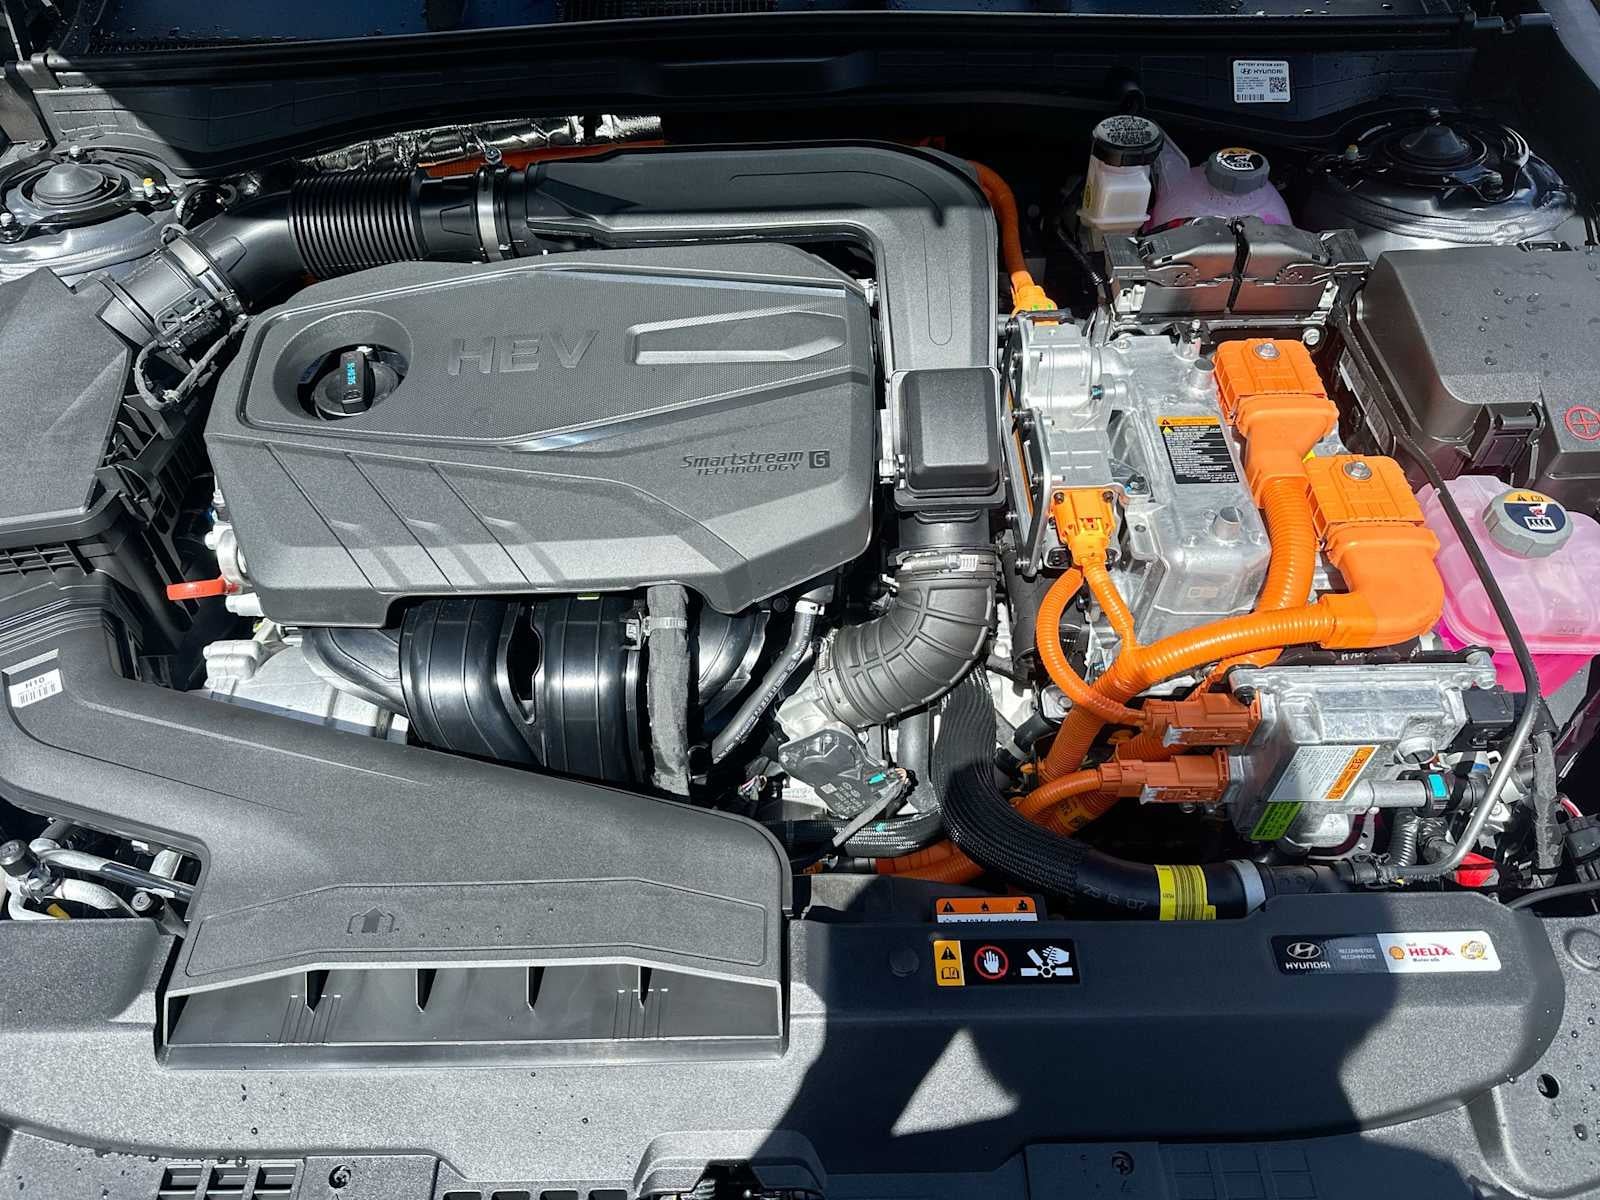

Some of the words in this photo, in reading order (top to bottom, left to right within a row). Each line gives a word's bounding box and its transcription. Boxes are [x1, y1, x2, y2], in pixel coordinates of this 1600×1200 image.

[448, 329, 600, 376] HEV
[680, 451, 804, 469] Smartstream
[811, 451, 829, 468] G
[696, 462, 801, 477] TECHNOLOGY
[1408, 946, 1452, 957] HELIX
[1285, 960, 1332, 970] HYUNDAI
